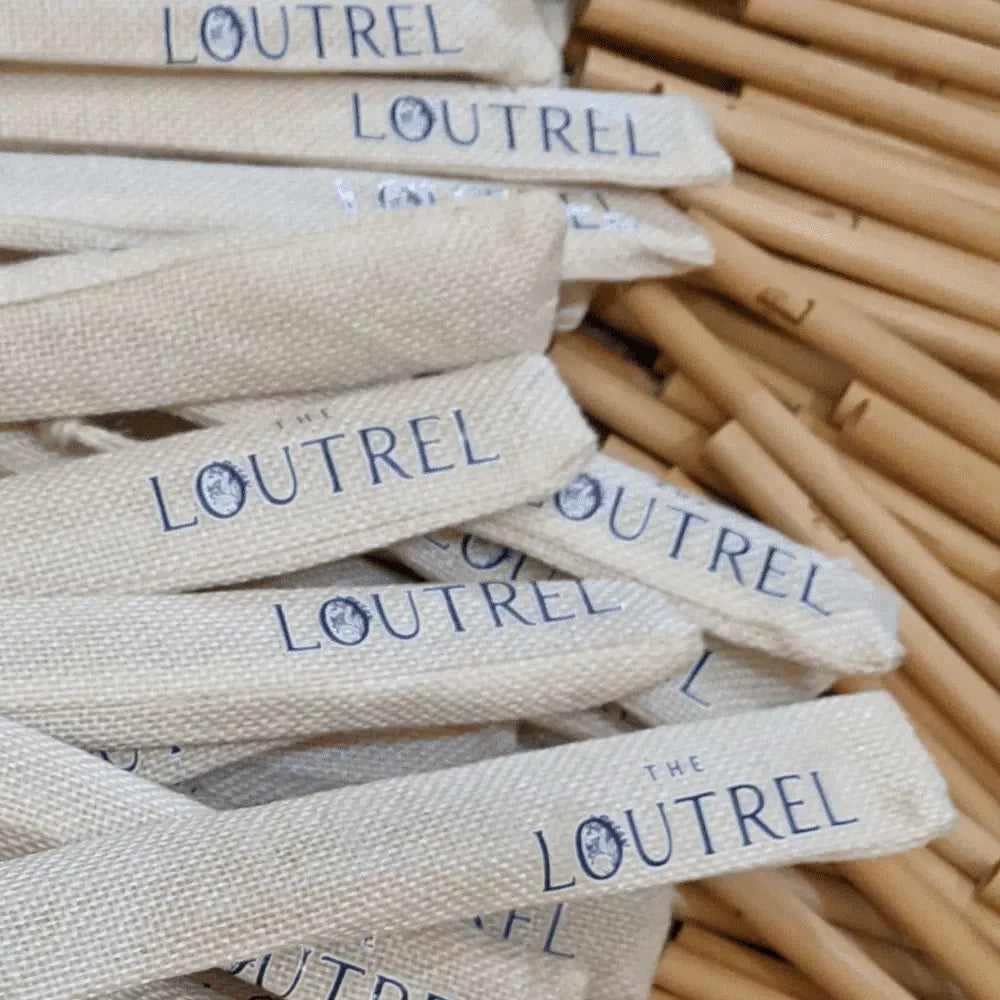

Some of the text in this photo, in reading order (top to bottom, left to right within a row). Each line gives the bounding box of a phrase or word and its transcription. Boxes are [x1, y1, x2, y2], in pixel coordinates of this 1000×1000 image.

[164, 4, 463, 65] LOUTREL
[350, 92, 662, 158] LOUTREL
[149, 408, 501, 532] LOUTREL
[527, 472, 834, 617] OUTREL
[273, 579, 623, 652] LOUTREL
[646, 758, 705, 783] THE
[535, 770, 858, 893] LOUTREL
